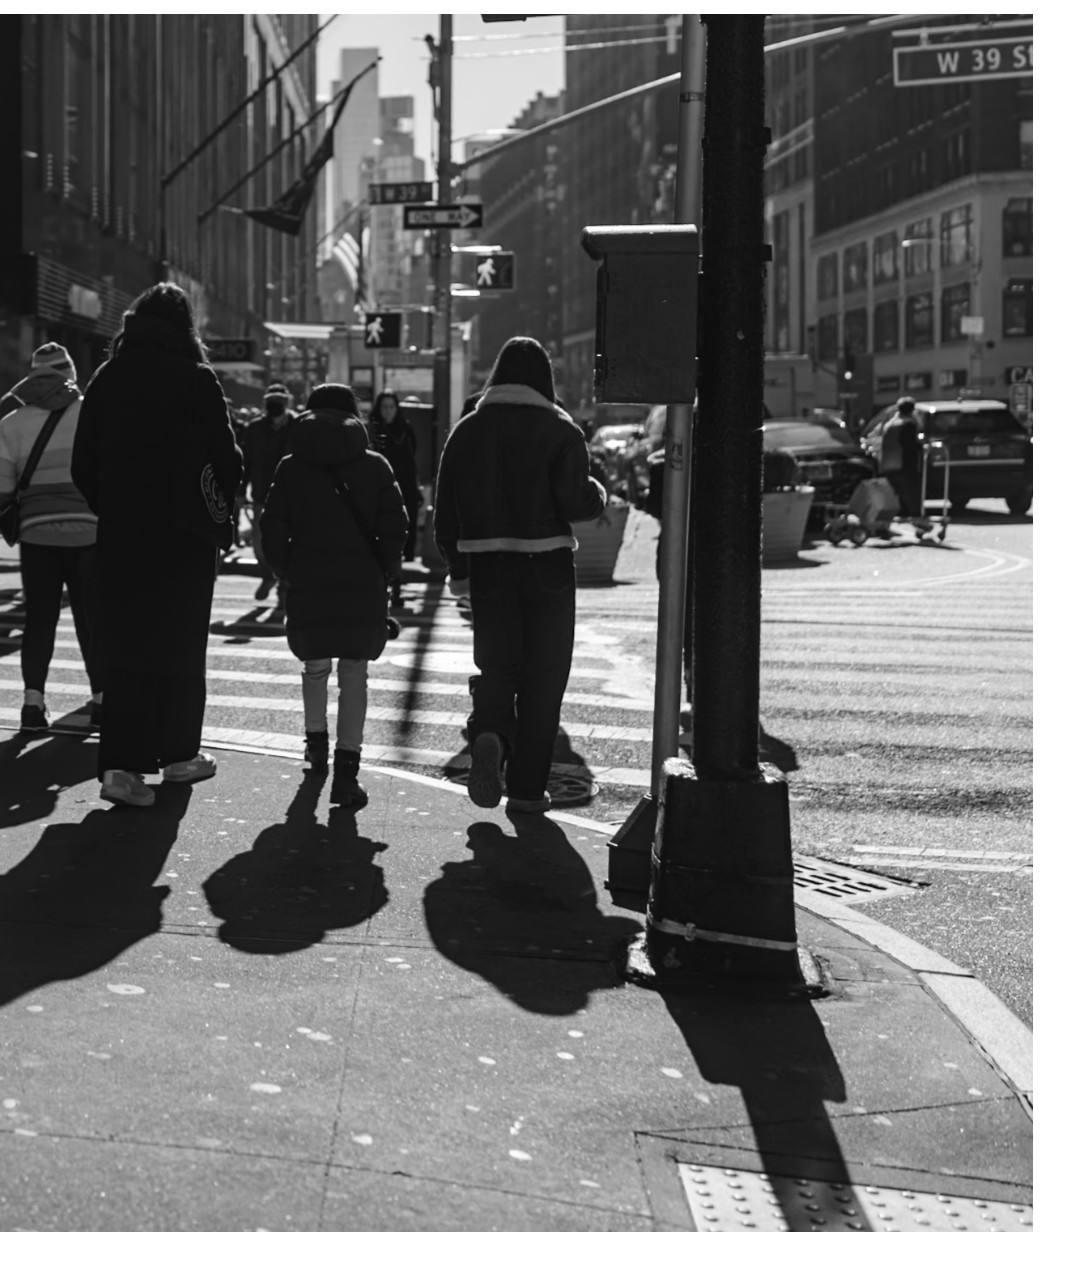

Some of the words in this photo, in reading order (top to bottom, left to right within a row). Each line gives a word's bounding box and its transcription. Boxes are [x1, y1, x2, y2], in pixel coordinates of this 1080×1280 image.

[935, 48, 961, 76] W
[970, 46, 1002, 73] 39
[398, 184, 418, 201] 39
